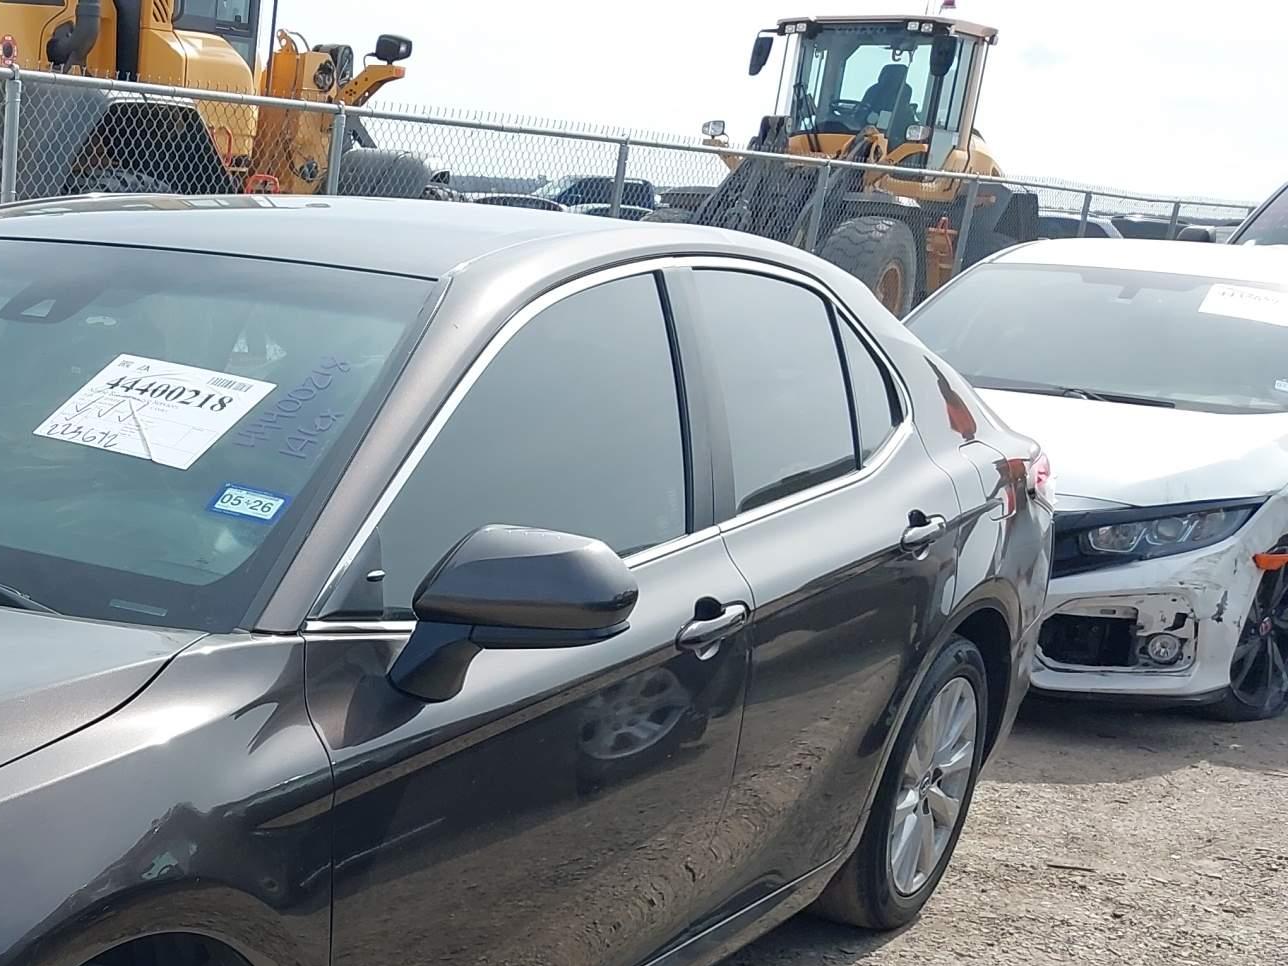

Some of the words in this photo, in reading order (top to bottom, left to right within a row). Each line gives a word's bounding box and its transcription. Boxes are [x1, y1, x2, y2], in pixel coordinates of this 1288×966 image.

[106, 376, 234, 412] 44400218
[220, 493, 243, 506] 05
[249, 500, 274, 513] 26
